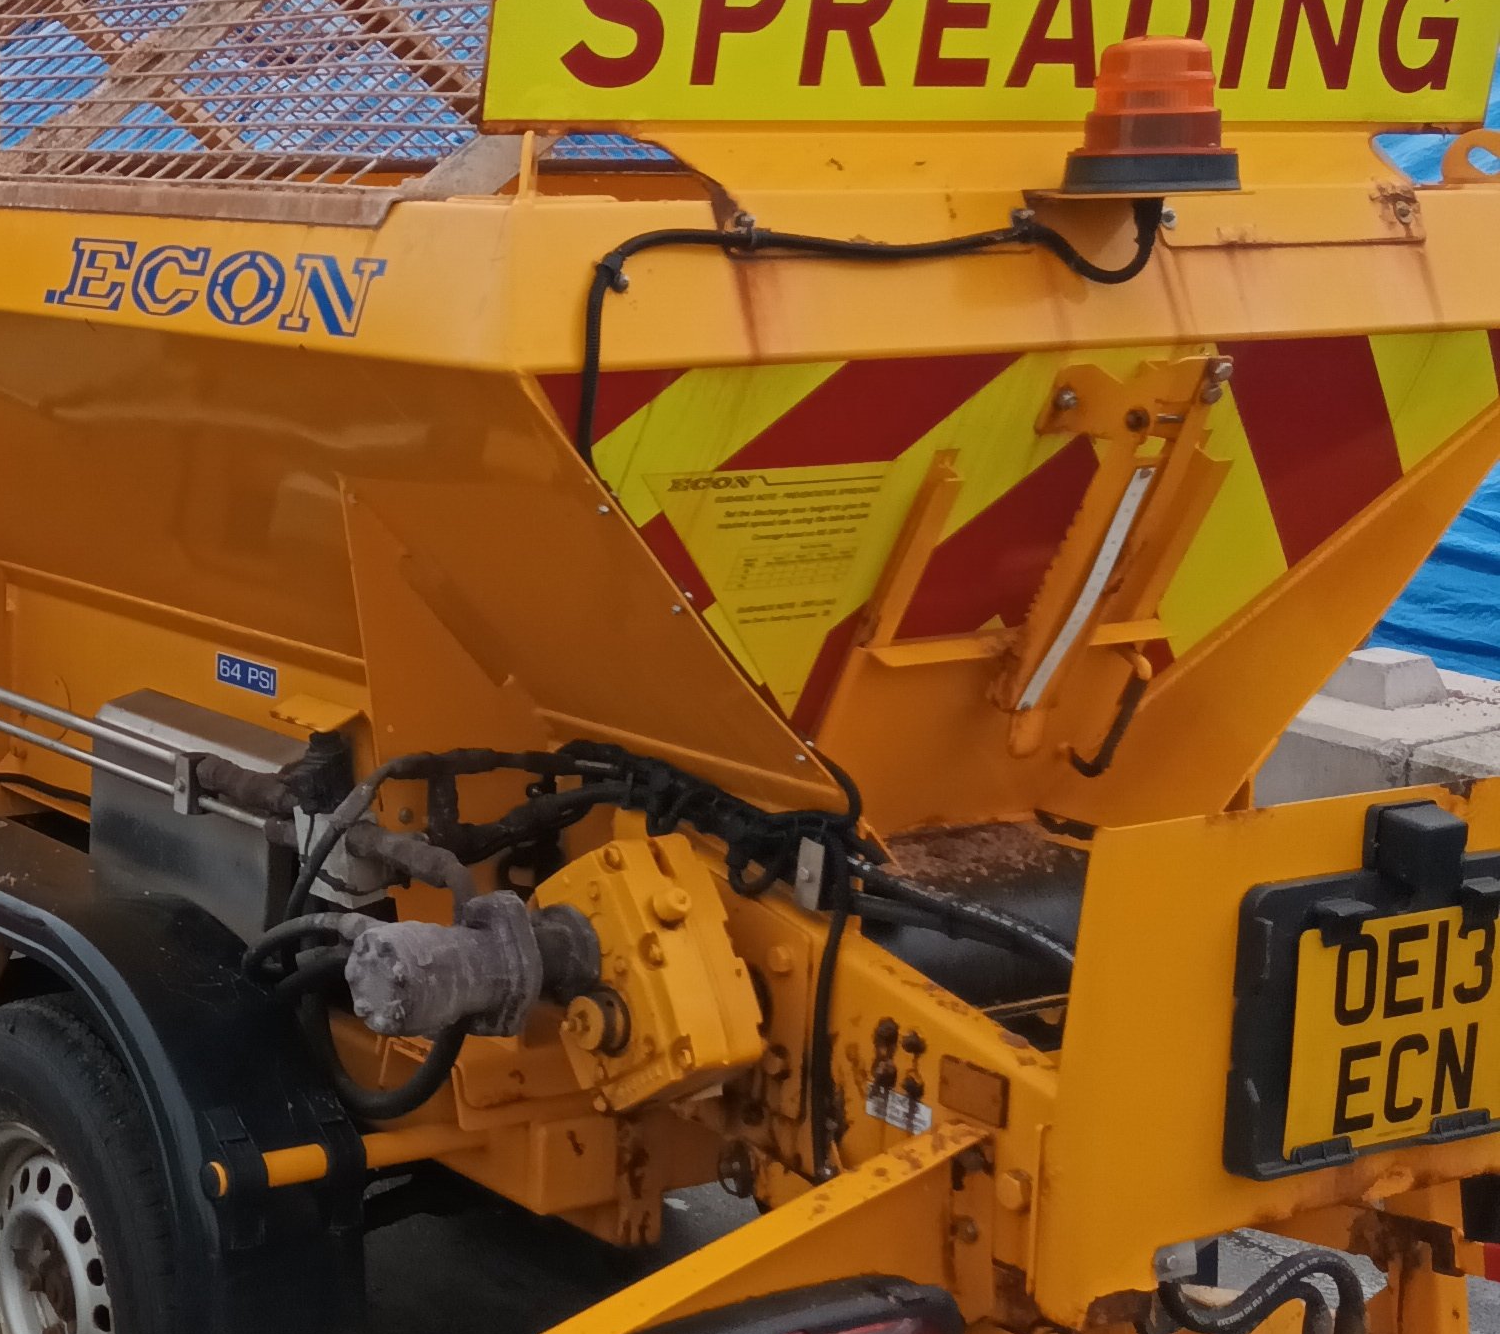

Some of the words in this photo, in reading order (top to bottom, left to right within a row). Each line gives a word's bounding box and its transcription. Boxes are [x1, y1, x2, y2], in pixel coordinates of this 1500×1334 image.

[44, 237, 388, 338] ECON
[667, 474, 758, 492] ECON
[219, 658, 242, 681] 64
[247, 666, 274, 691] PSI
[1334, 917, 1495, 1027] OE13
[1332, 1021, 1479, 1136] ECN
